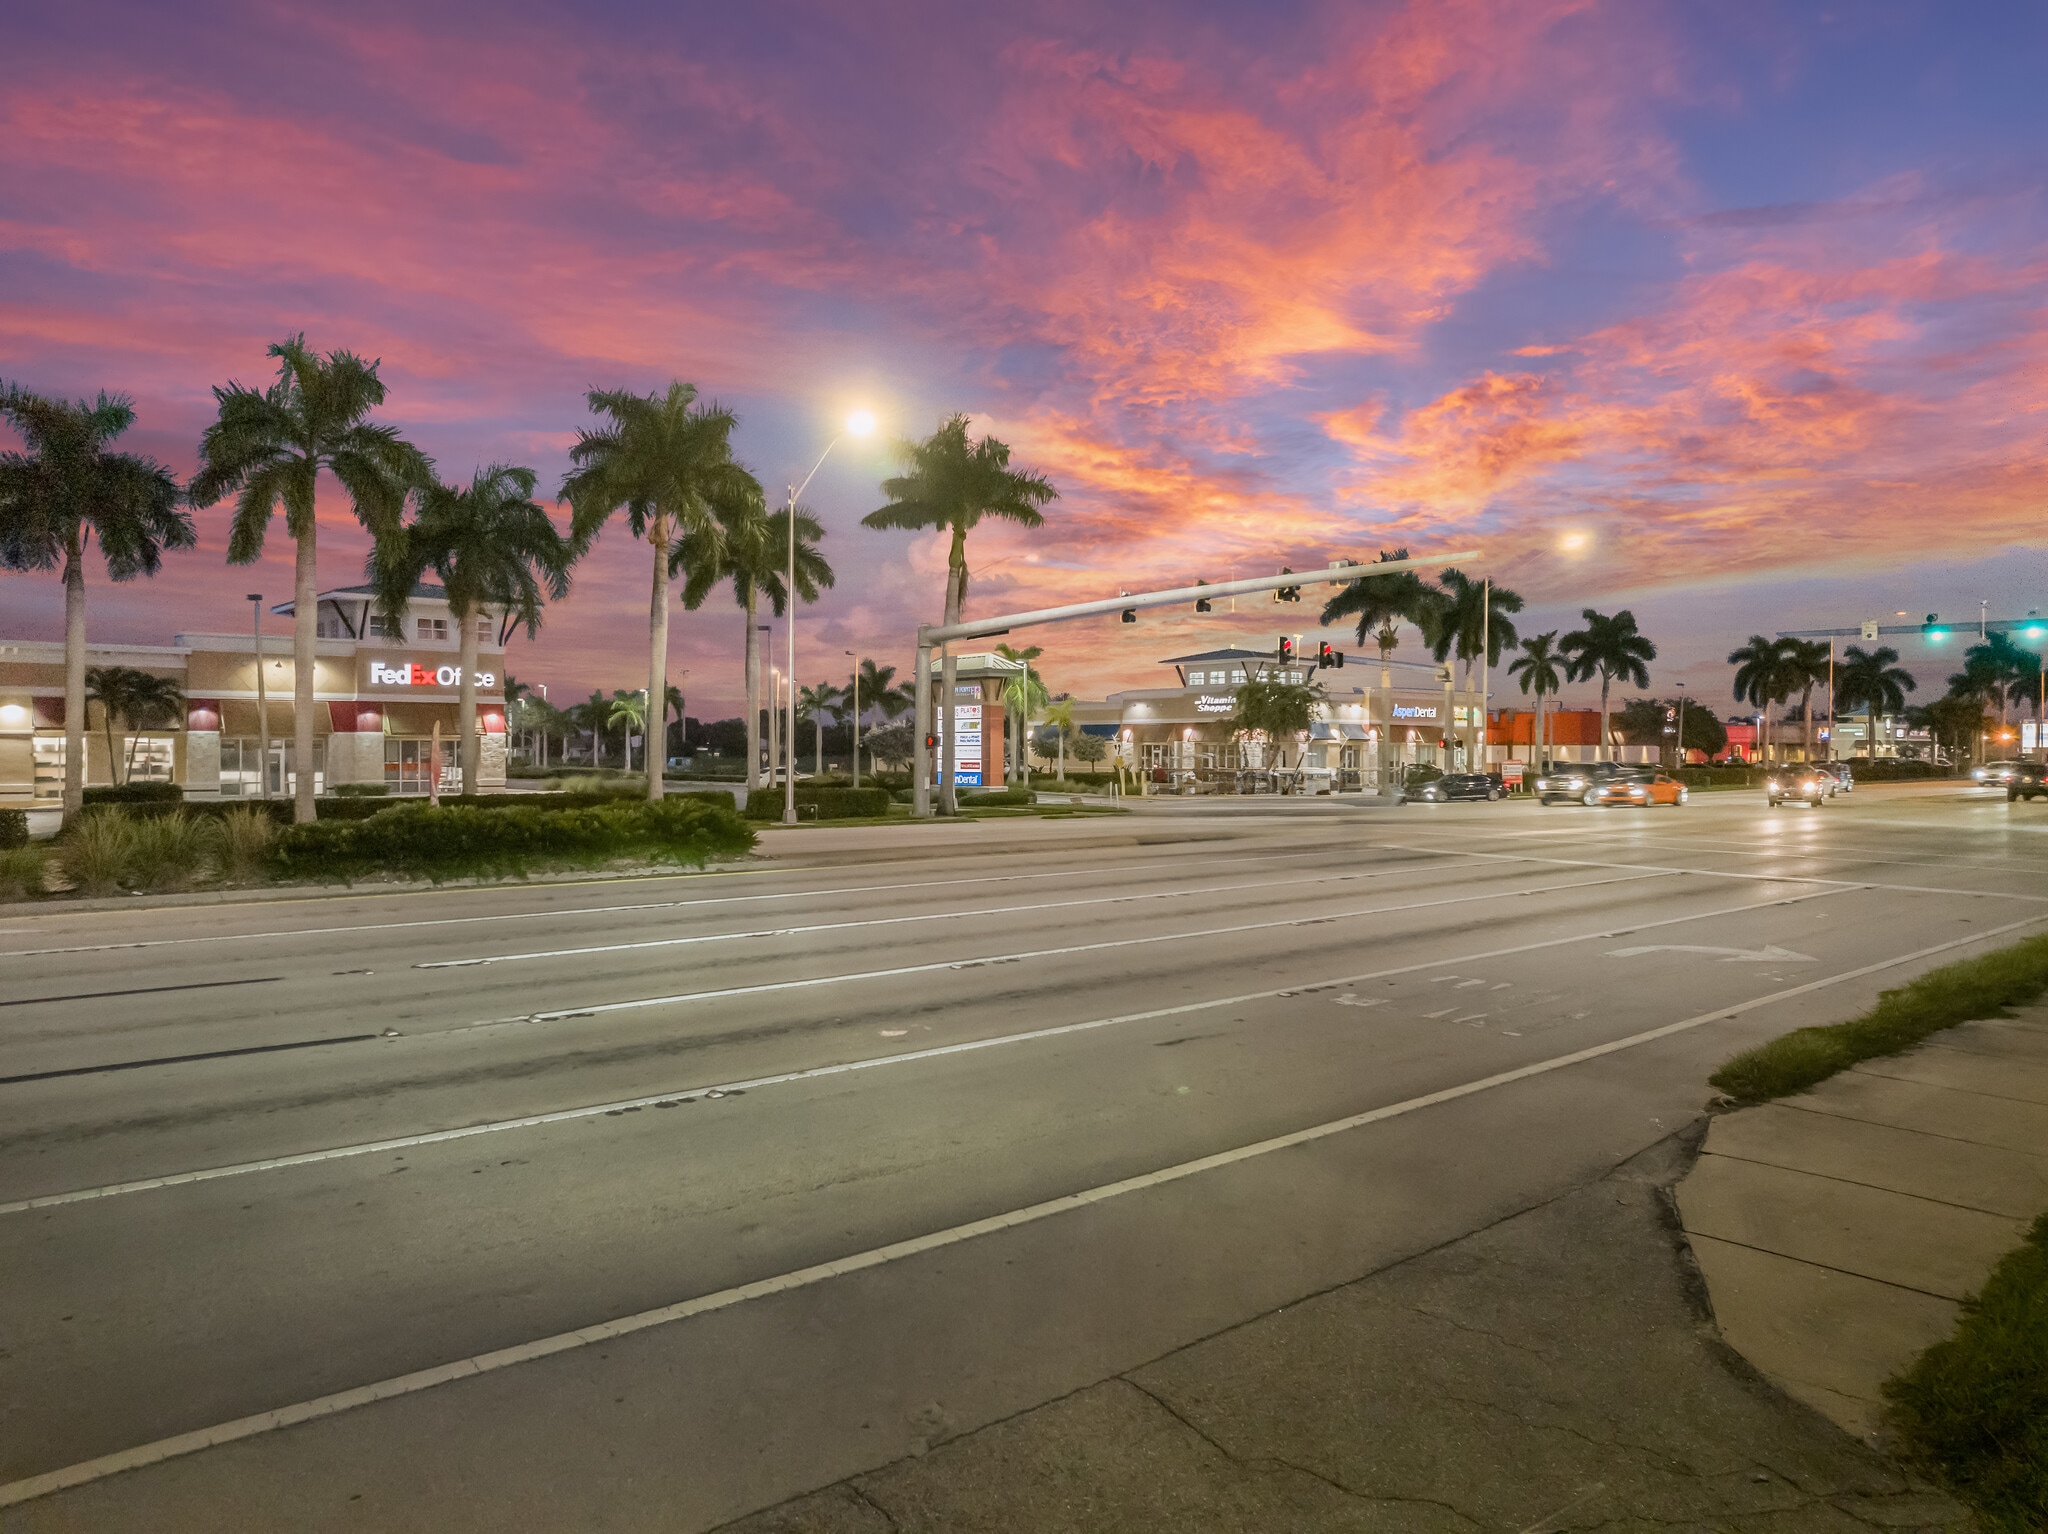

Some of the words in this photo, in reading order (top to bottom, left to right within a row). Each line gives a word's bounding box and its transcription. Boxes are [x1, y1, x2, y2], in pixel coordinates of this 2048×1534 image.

[437, 666, 495, 687] Ofce
[1200, 695, 1237, 704] Vitamin
[1197, 704, 1233, 713] Shoppe
